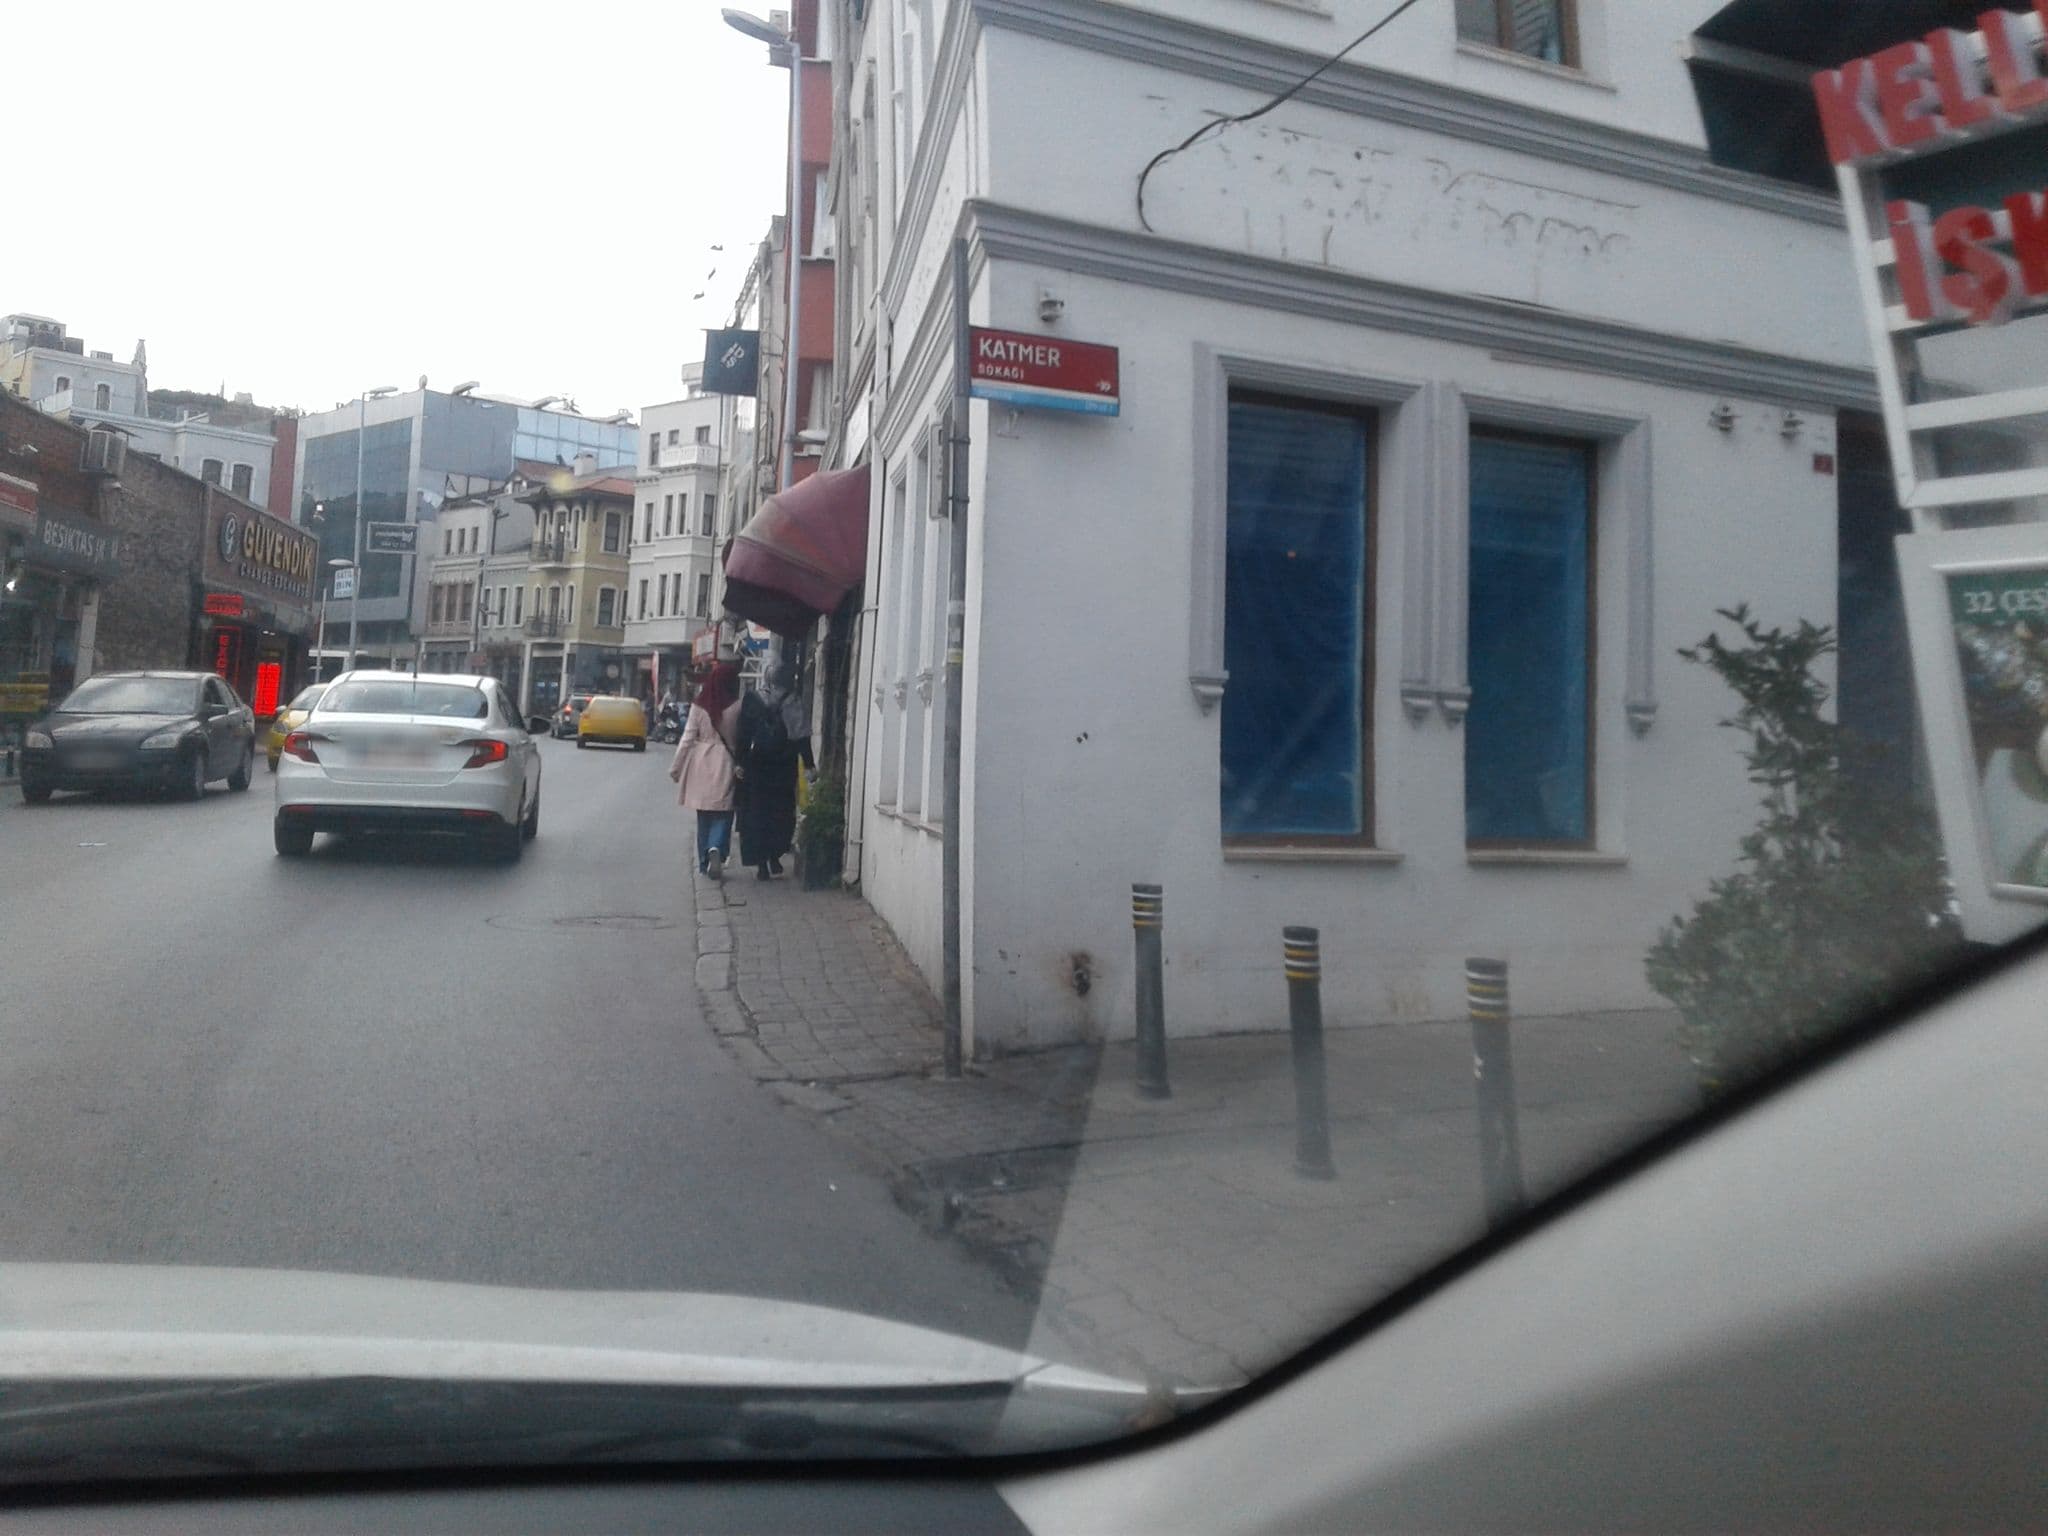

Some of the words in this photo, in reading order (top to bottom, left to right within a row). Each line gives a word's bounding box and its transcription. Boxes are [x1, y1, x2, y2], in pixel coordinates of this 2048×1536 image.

[979, 337, 1061, 368] KATMER
[243, 515, 312, 580] GÜVENDİK
[1963, 591, 2000, 616] 32
